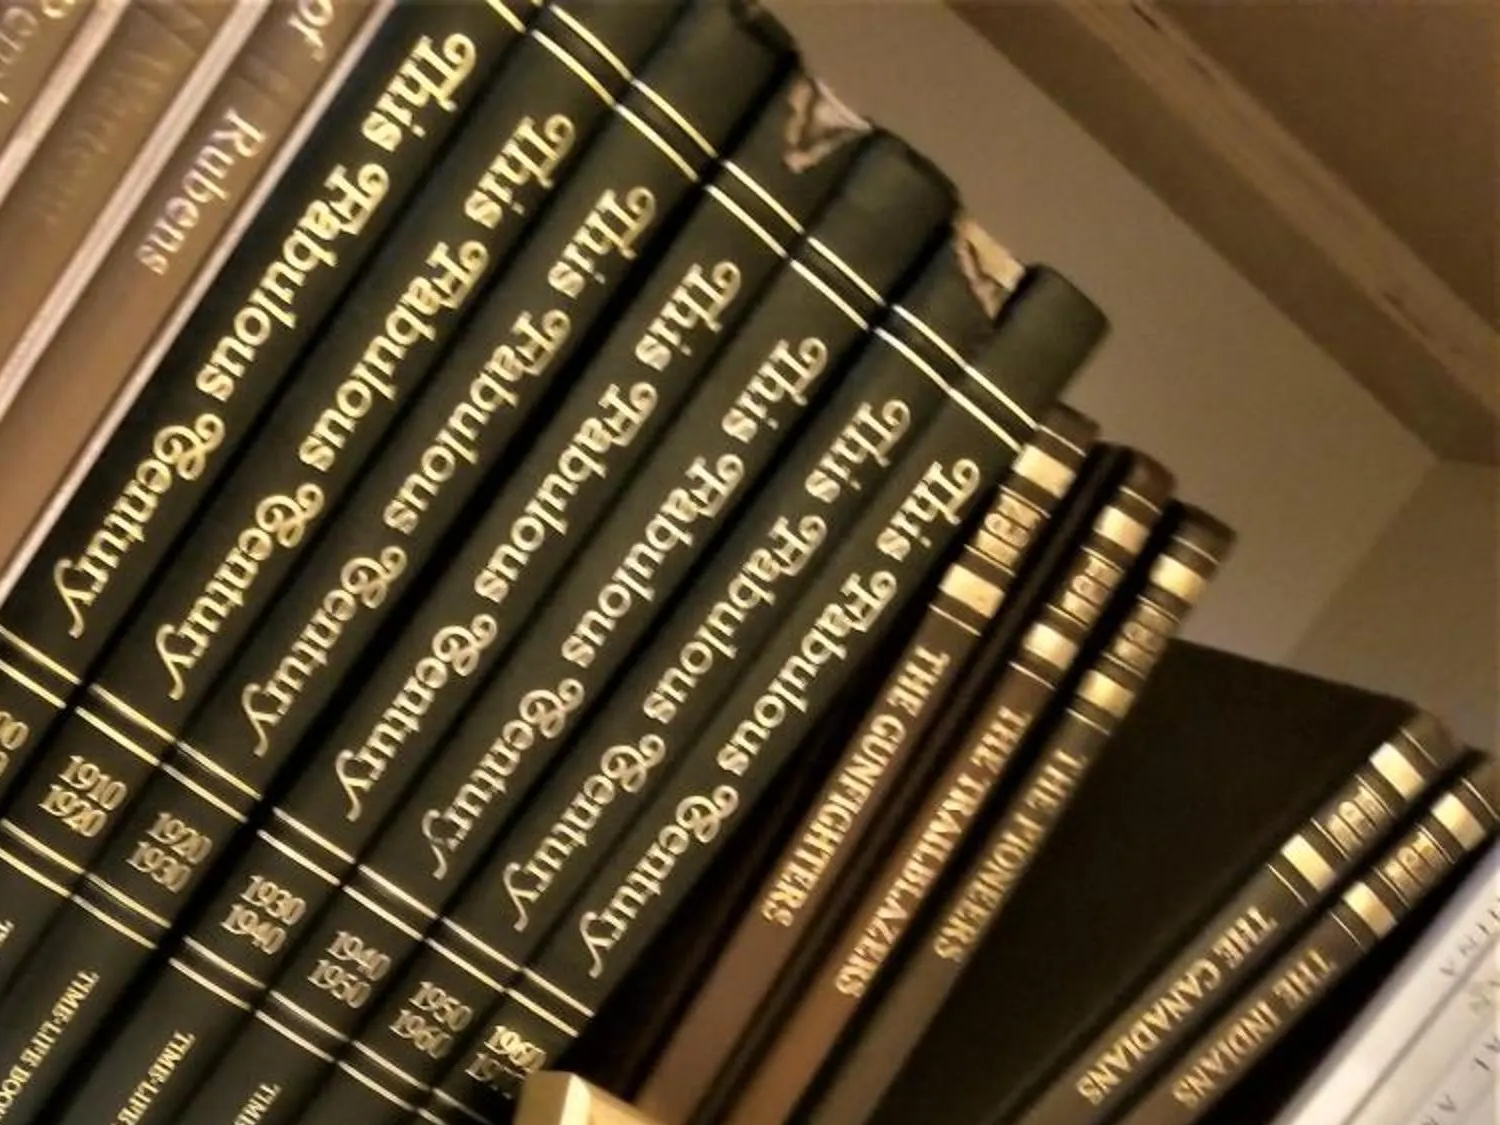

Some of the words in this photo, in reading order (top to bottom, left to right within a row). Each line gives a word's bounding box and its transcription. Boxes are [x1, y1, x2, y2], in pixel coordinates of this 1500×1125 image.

[275, 0, 350, 64] of
[361, 31, 477, 153] This
[140, 108, 268, 276] Rubens
[463, 113, 575, 229] This
[195, 162, 390, 403] Fabulous
[546, 186, 655, 299] This
[298, 239, 489, 473] Fabulous
[634, 260, 742, 372] This
[382, 308, 571, 535] Fabulous
[720, 336, 828, 444] This
[473, 380, 658, 604] Fabulous
[804, 398, 911, 504] This
[53, 411, 226, 640] Century
[560, 452, 745, 669] Fabulous
[875, 457, 981, 562] This
[154, 481, 325, 701] Century
[642, 514, 828, 725] Fabulous
[241, 544, 408, 757] Century
[716, 569, 898, 777] Fabulous
[883, 639, 950, 719] THE
[334, 612, 499, 822] Century
[967, 701, 1032, 777] THE
[35, 779, 109, 841] 1920
[53, 750, 130, 814] 1910
[421, 677, 585, 881] Century
[502, 732, 667, 932] Century
[755, 708, 909, 932] GUNFIGHTERS
[1018, 742, 1087, 823] THE
[124, 836, 193, 895] 1930
[143, 807, 215, 868] 1920
[578, 783, 740, 979] Century
[828, 766, 992, 1002] TRAILBLAZERS
[928, 810, 1045, 967] PIONEERS
[218, 900, 288, 958] 1940
[237, 870, 308, 930] 1930
[324, 927, 393, 983] 1940
[1207, 905, 1280, 971] THE
[303, 954, 374, 1012] 1950
[385, 1004, 456, 1063] 1960
[405, 977, 475, 1034] 1950
[1069, 955, 1226, 1108] CANADIANS
[1265, 950, 1340, 1009] THE
[1167, 1000, 1286, 1111] INDIANS
